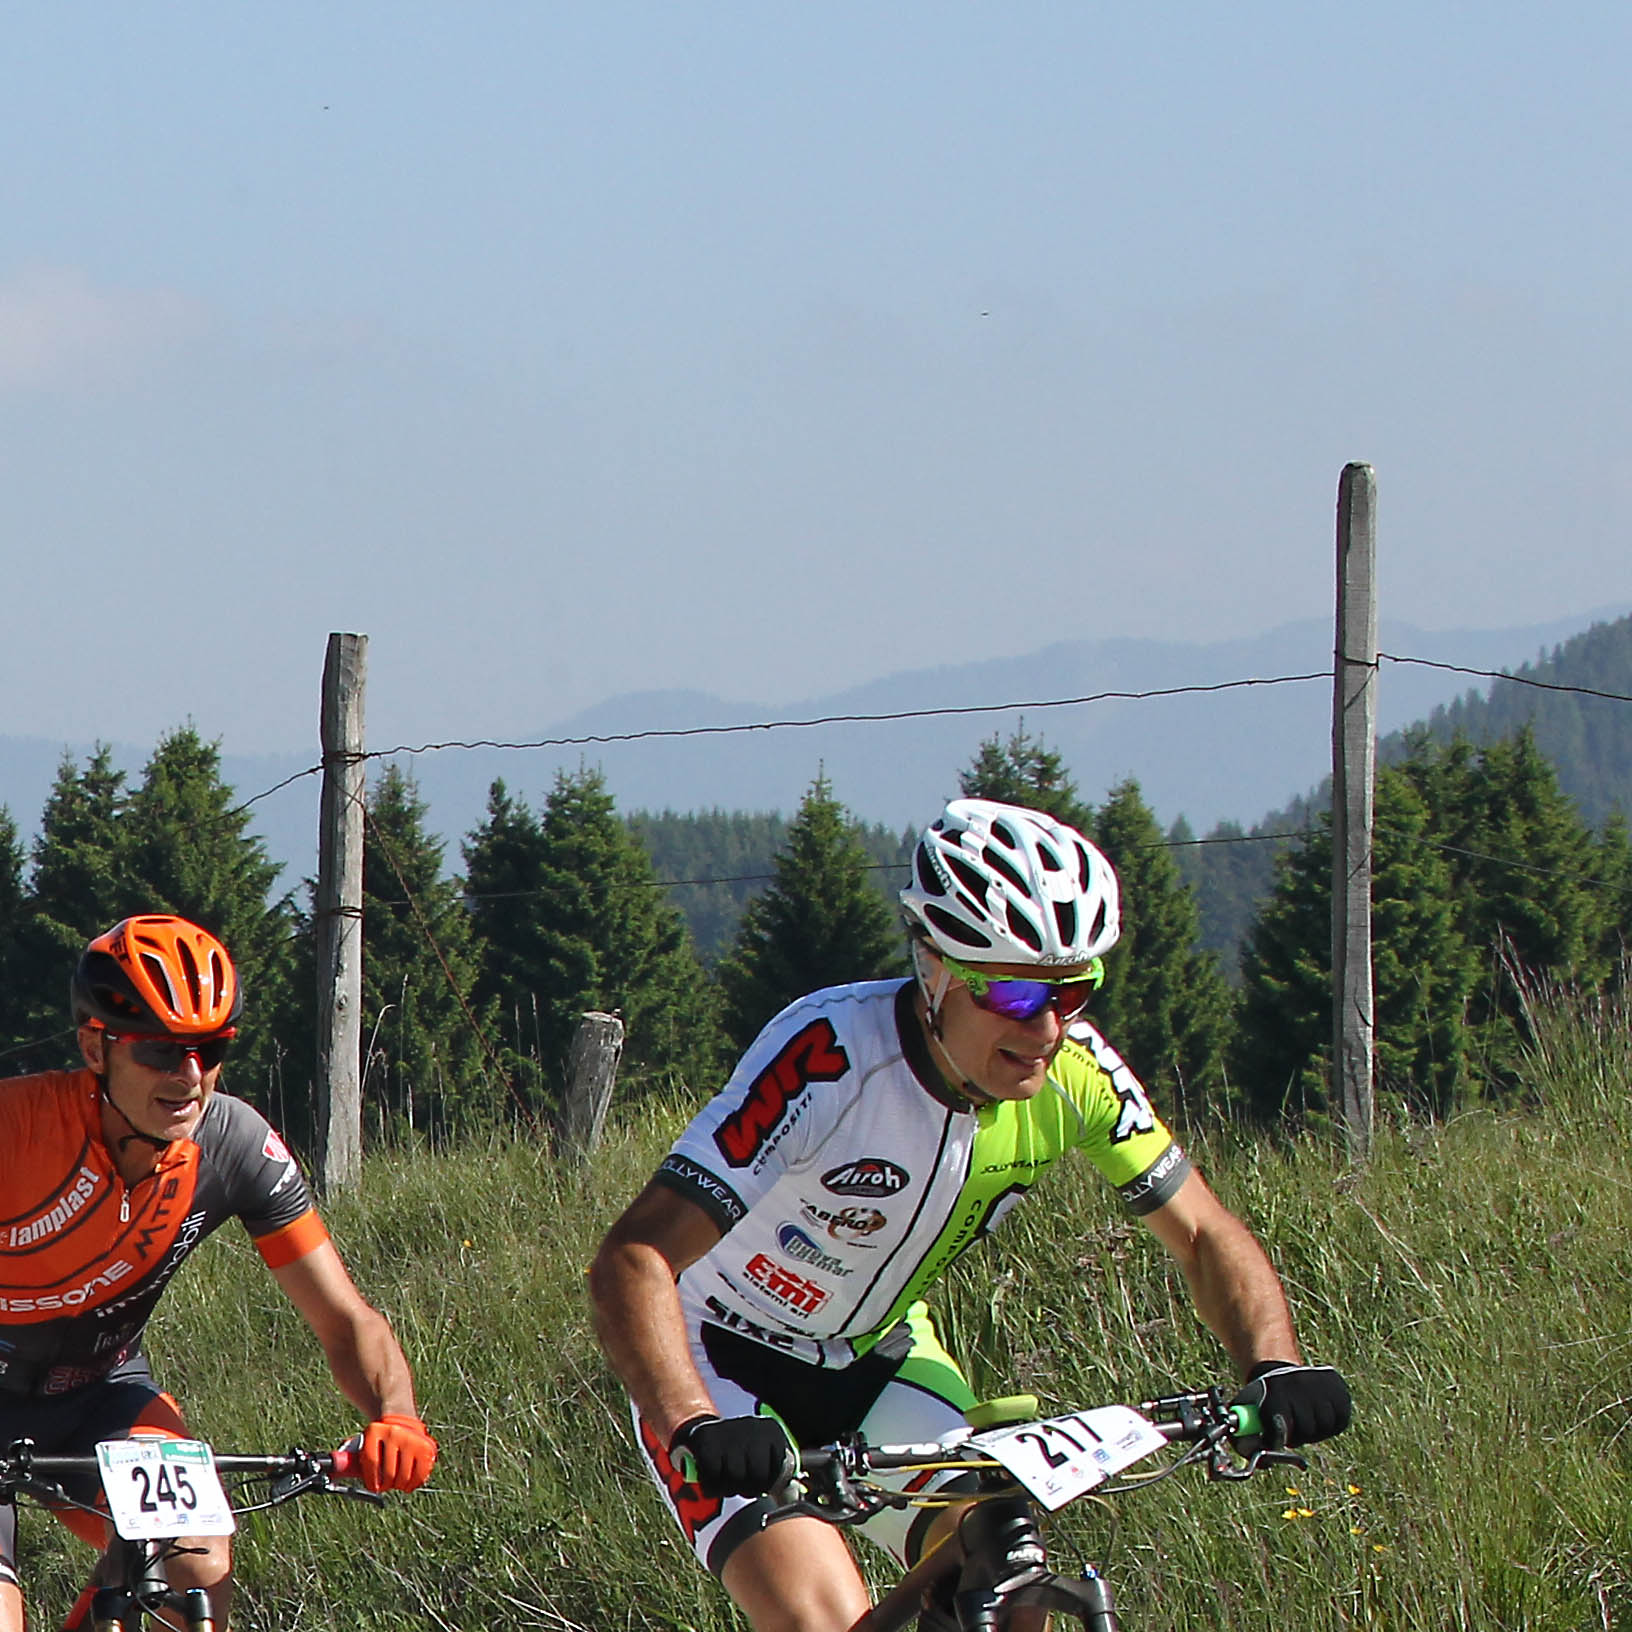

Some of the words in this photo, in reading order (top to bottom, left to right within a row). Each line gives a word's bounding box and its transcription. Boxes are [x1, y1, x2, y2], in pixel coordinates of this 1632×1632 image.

[753, 1092, 812, 1176] COMPOSITI
[9, 1165, 101, 1247] lamplast
[828, 1168, 901, 1190] Airoh
[135, 1177, 179, 1261] MTB
[1016, 1415, 1104, 1469] 217
[131, 1464, 197, 1513] 245
